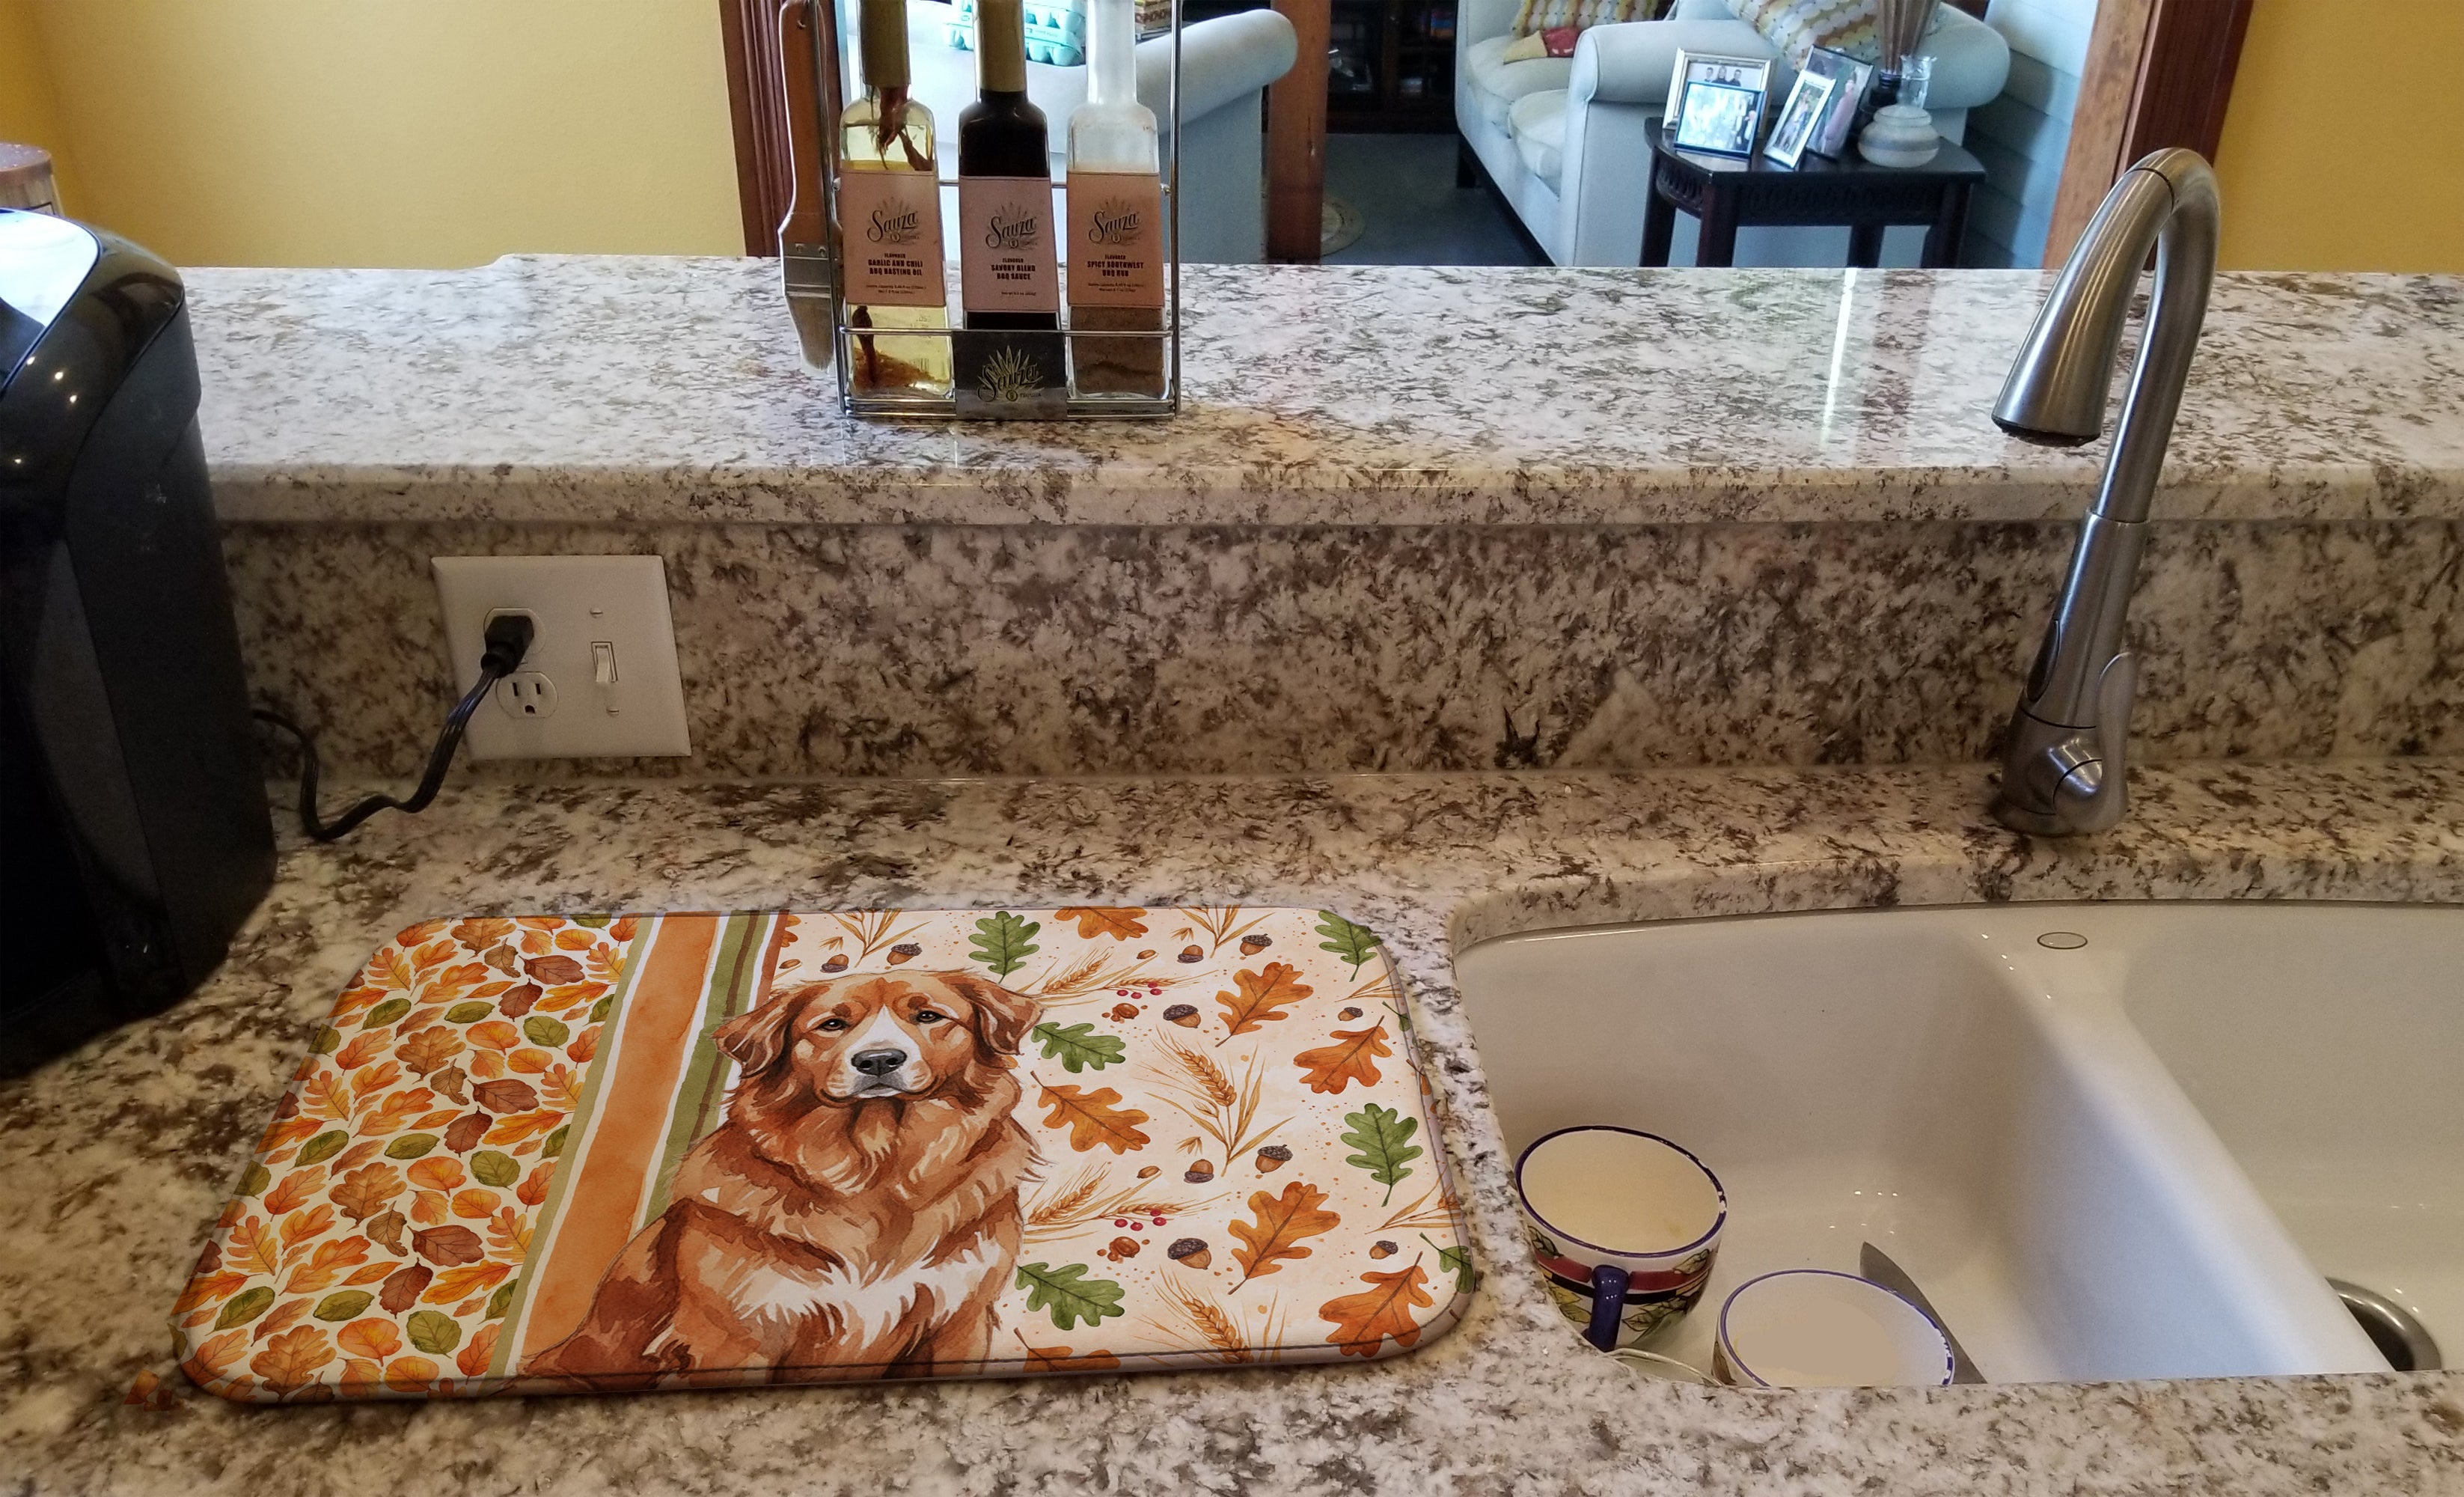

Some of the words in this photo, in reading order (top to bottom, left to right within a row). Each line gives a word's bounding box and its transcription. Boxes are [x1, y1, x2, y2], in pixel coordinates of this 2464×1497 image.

[866, 210, 919, 243] Sauza
[985, 216, 1037, 249] Sauza
[1088, 210, 1140, 244] Sauza
[869, 267, 883, 275] BBQ
[884, 267, 911, 275] BASTING
[1107, 261, 1144, 269] SOUTHWEST
[977, 365, 1044, 402] Sauza
